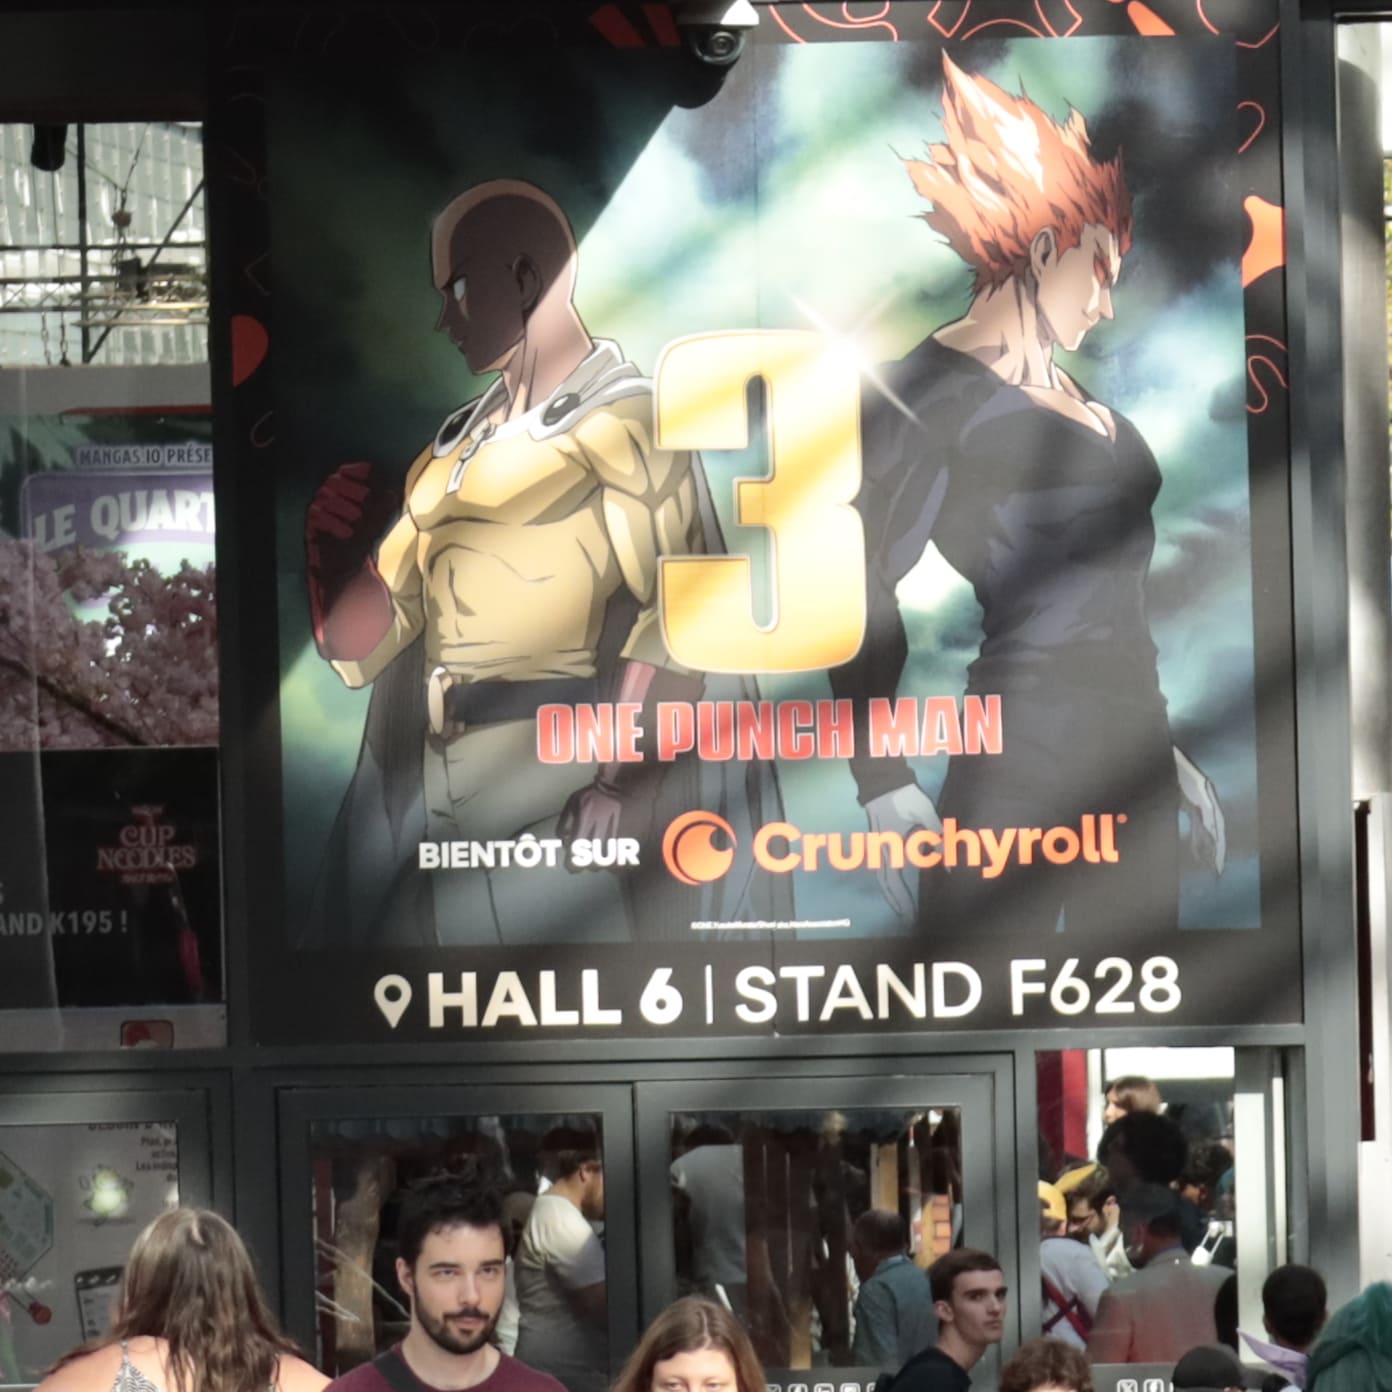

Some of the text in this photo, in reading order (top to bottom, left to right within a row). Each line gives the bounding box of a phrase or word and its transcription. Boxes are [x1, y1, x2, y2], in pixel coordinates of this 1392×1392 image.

[32, 504, 77, 549] LE
[652, 329, 865, 674] 3
[536, 694, 1003, 764] ONE PUNCH MAN
[97, 845, 196, 870] NOODLES
[119, 825, 176, 847] CUP
[419, 814, 1119, 878] BIENTÔT SUR Crunchyroll
[50, 909, 113, 935] K195
[428, 956, 1182, 1029] HALL 6 STAND F628
